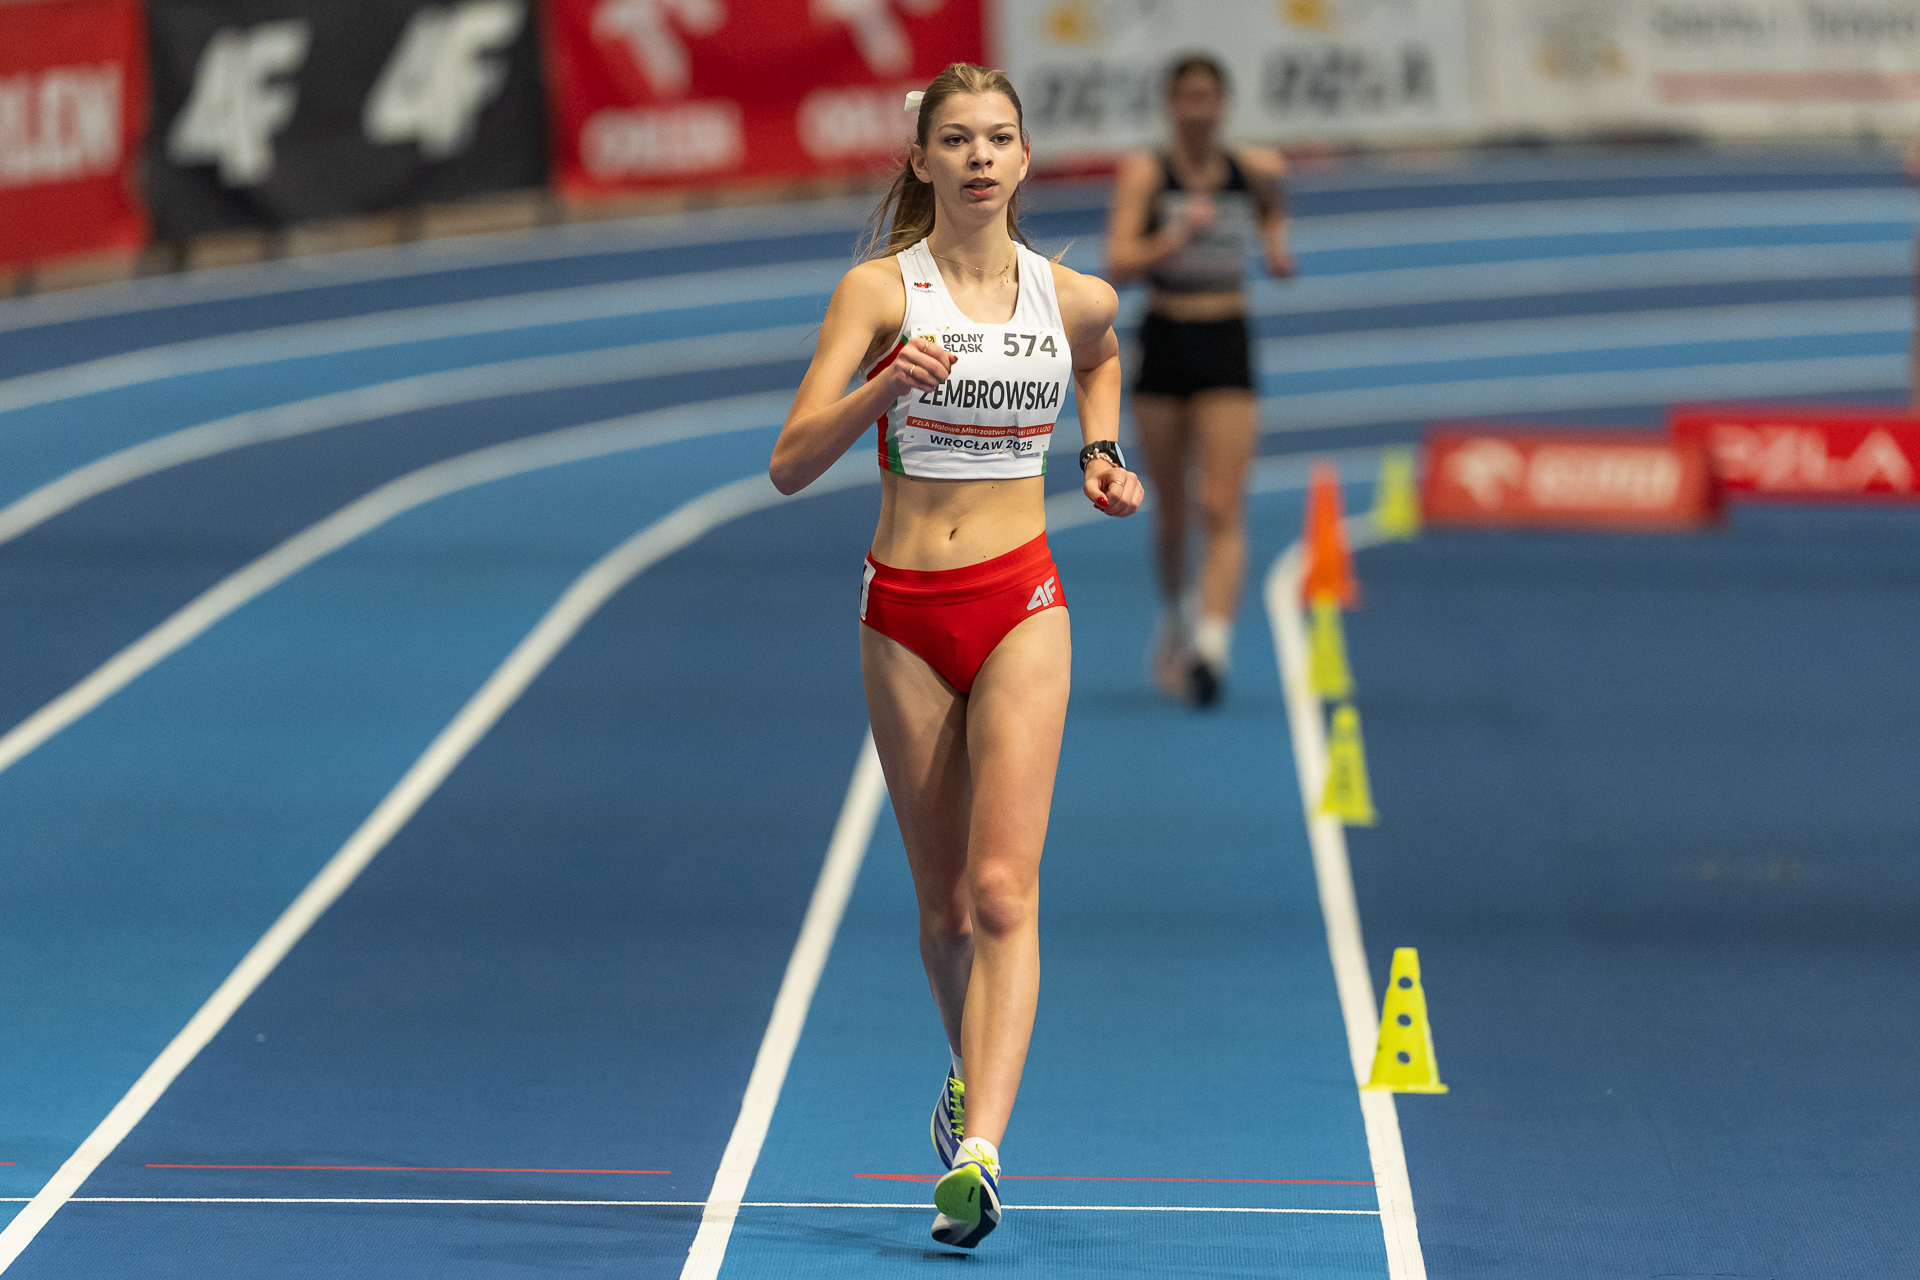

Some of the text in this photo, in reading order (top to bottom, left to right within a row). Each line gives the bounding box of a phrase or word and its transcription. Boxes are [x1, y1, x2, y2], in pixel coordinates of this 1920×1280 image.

[167, 18, 311, 187] 4F
[942, 333, 984, 343] DOLNY
[1003, 333, 1058, 358] 574
[943, 342, 983, 354] ŚLĄSK
[912, 419, 930, 428] PZLA
[931, 422, 960, 433] Halowe
[961, 427, 1006, 435] Mistrzostwa
[930, 434, 1033, 451] WROCŁAW 2025
